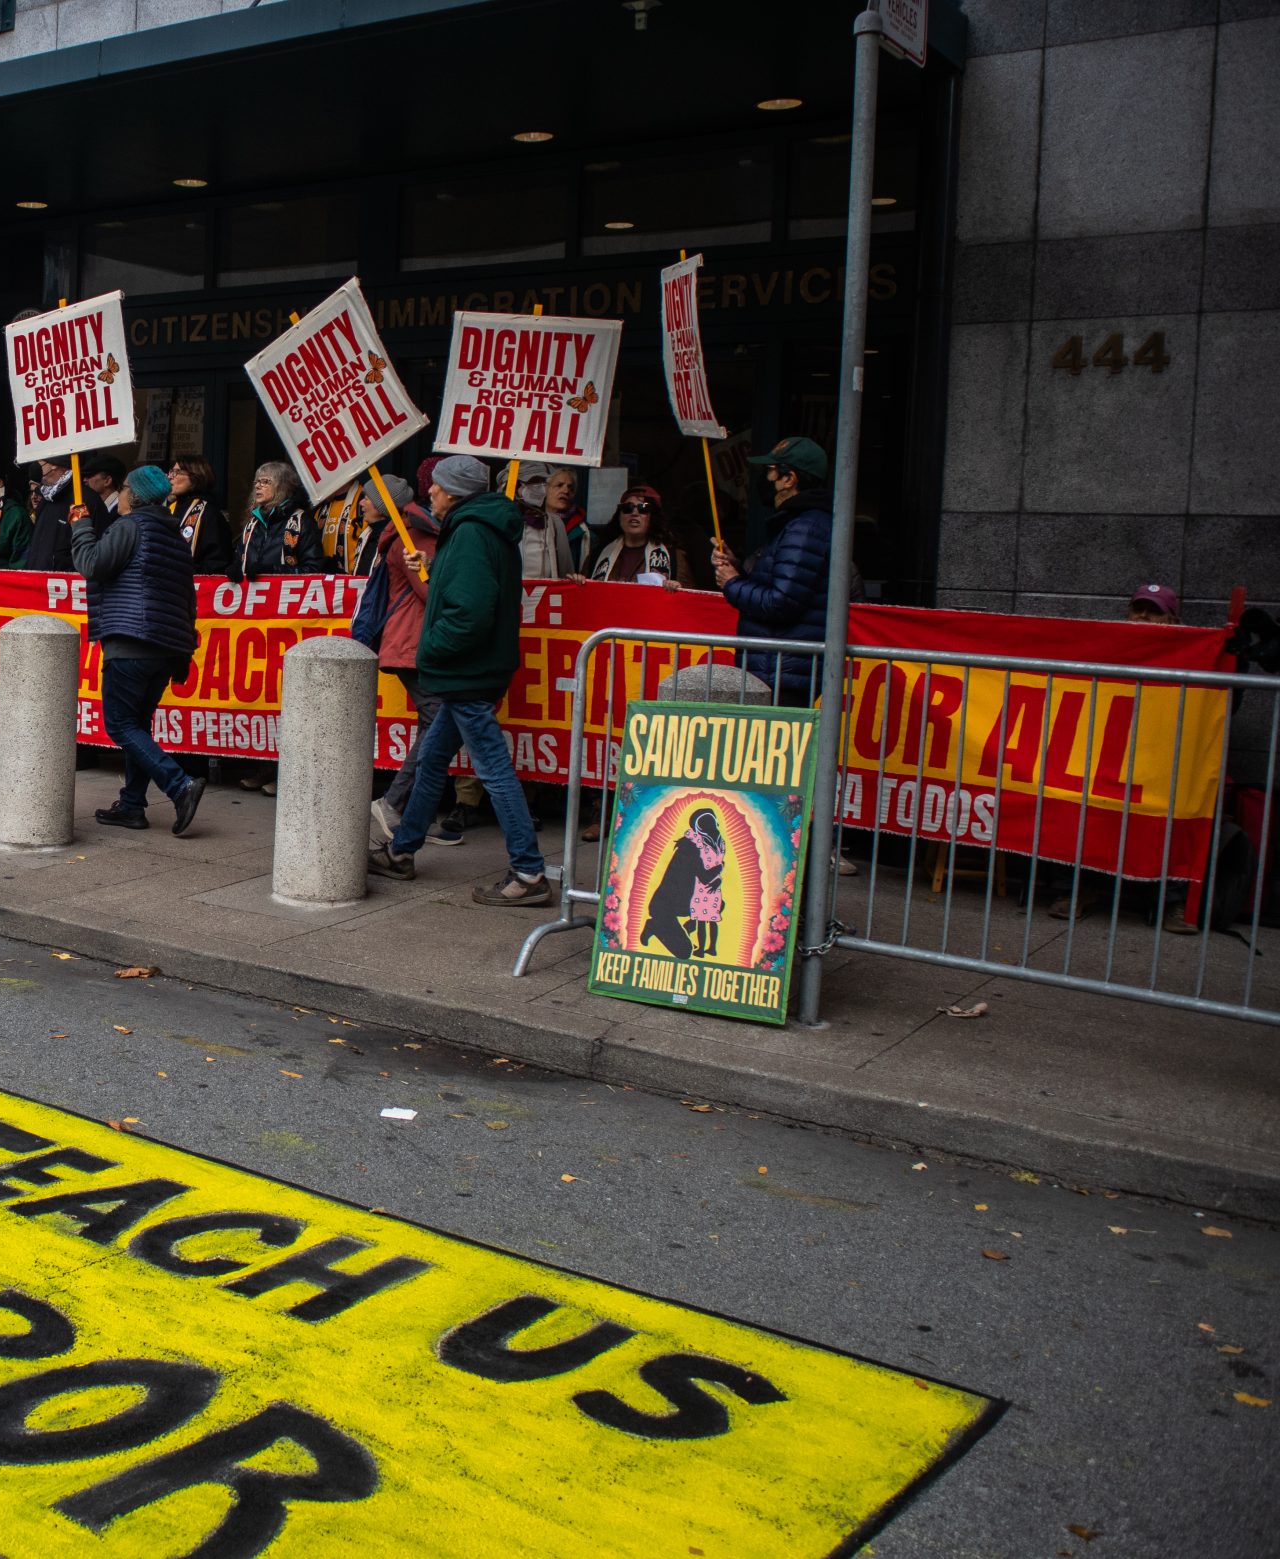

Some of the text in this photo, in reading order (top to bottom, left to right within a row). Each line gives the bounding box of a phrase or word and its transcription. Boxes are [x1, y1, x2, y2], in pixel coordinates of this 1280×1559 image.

[698, 263, 897, 311] ERVICS
[13, 311, 104, 376] DIGNITY
[24, 354, 103, 388] & HUMAN
[260, 309, 363, 416] DIGNITY
[458, 326, 595, 378] DIGNITY
[1052, 332, 1170, 375] 444
[35, 374, 96, 402] RIGHTS
[288, 356, 367, 423] & HUMAN
[303, 379, 366, 434] RIGHTS
[467, 371, 578, 395] & HUMAN
[476, 388, 563, 411] RIGHTS
[22, 386, 119, 445] FOR ALL
[296, 384, 408, 483] FOR ALL
[448, 403, 584, 456] FOR ALL
[212, 581, 270, 616] OF
[624, 713, 813, 788] SANCTUARY
[978, 684, 1143, 804] ALL
[190, 711, 280, 752] PERSON
[877, 776, 996, 842] TODOS
[595, 952, 781, 1009] KEEP FAMILIES TOGETHER
[437, 1294, 789, 1441] US
